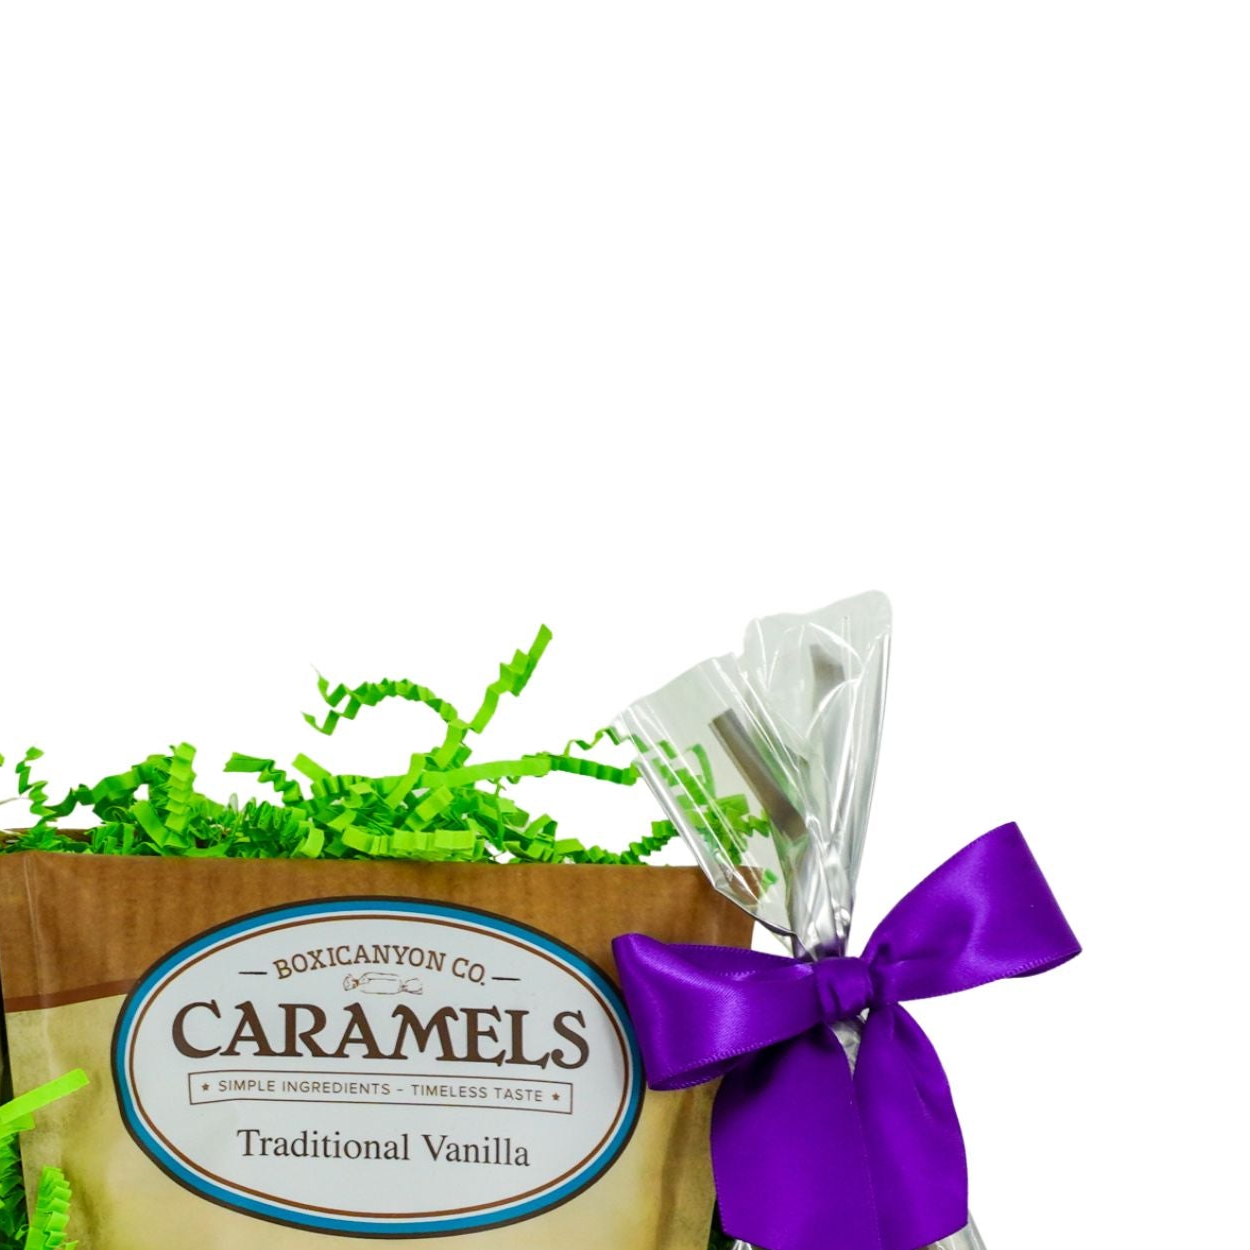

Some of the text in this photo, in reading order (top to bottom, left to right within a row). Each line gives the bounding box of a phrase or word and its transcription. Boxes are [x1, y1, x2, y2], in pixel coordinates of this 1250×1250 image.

[272, 944, 486, 986] BOXICANYON CO.
[171, 998, 590, 1071] CARAMELS
[218, 1080, 544, 1103] SIMPLE INGREDIENTS TIMELESS TASTE
[236, 1128, 530, 1167] Traditional Vanilla
